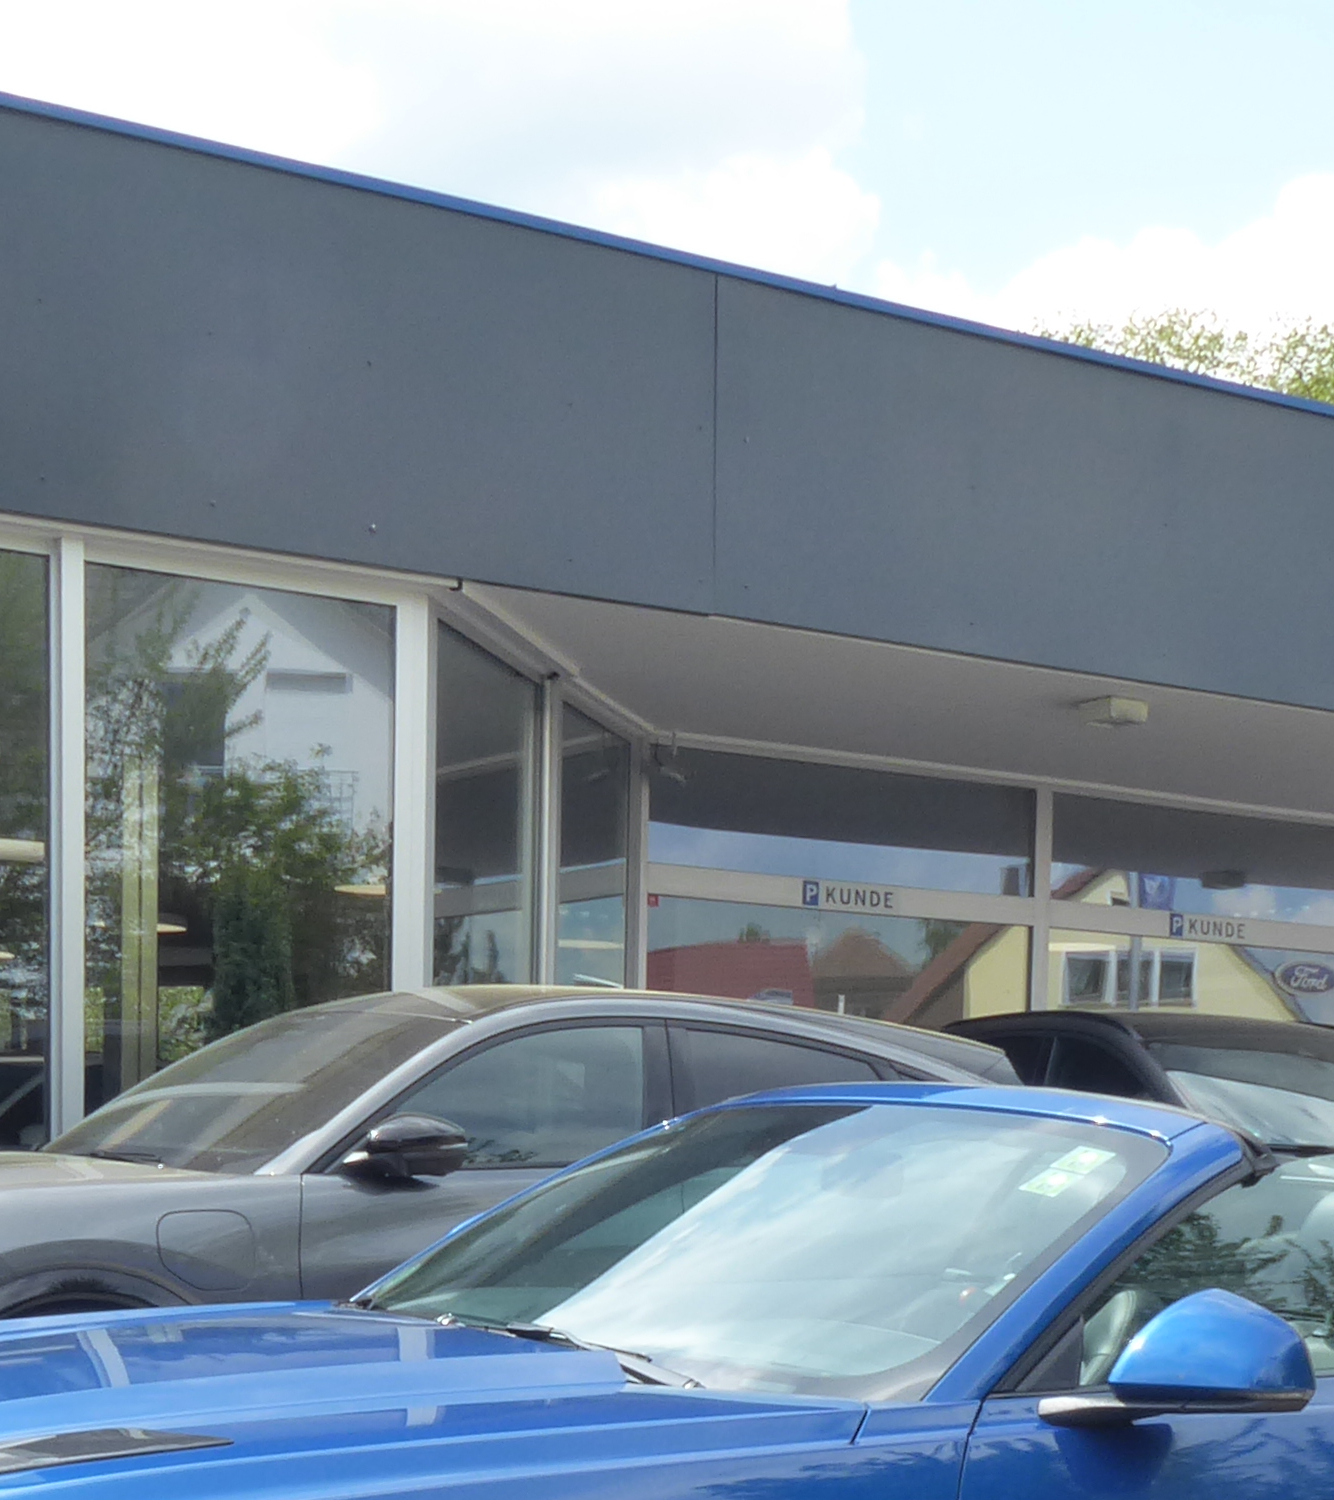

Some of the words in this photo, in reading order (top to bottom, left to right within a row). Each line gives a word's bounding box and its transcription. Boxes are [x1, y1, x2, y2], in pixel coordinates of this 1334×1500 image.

[825, 886, 894, 909] KUNDE
[1188, 918, 1246, 939] KUNDE
[1290, 966, 1329, 992] Ford
